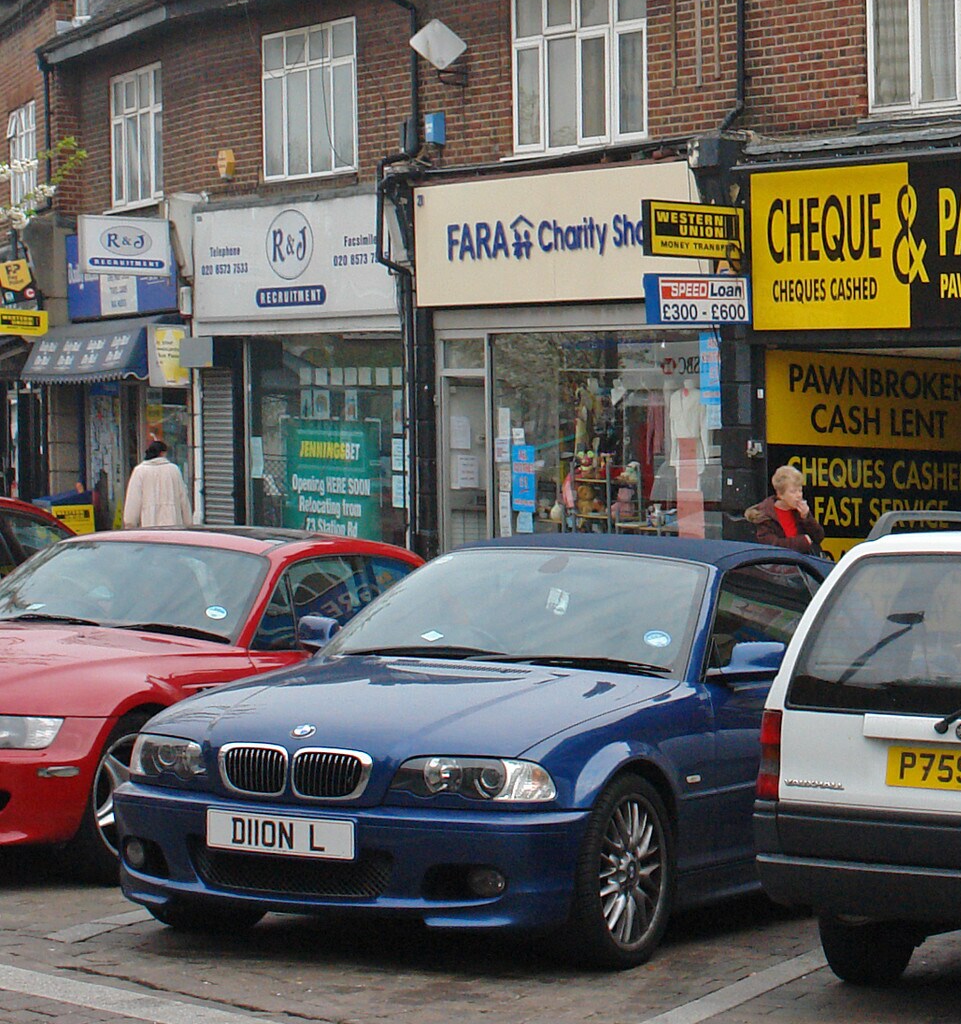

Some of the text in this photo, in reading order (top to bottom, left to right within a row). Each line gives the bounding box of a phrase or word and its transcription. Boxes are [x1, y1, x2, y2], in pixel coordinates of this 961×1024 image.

[656, 210, 724, 227] WESTERN
[447, 214, 644, 262] FARA Charity Sho
[679, 224, 724, 238] UNION
[768, 193, 882, 264] CHEQUE
[892, 184, 929, 284] &
[344, 233, 377, 248] Facsimile
[661, 240, 690, 250] MONEY
[209, 246, 241, 258] Telephone
[94, 258, 160, 268] RECRUITMENT
[333, 255, 348, 267] 020
[201, 265, 213, 275] 020
[260, 288, 322, 305] RECRUITMENT
[670, 282, 742, 298] SPEED Loan
[773, 276, 878, 303] CHEQUES CASHED
[662, 304, 698, 320] £300
[711, 304, 746, 320] £600
[811, 403, 948, 438] CASH LENT
[300, 441, 360, 461] JENNINGSBET
[292, 473, 370, 496] Opening HERE SOON
[299, 495, 362, 519] Relocating from
[814, 496, 863, 527] FAST
[318, 517, 346, 536] Station
[309, 824, 326, 852] L
